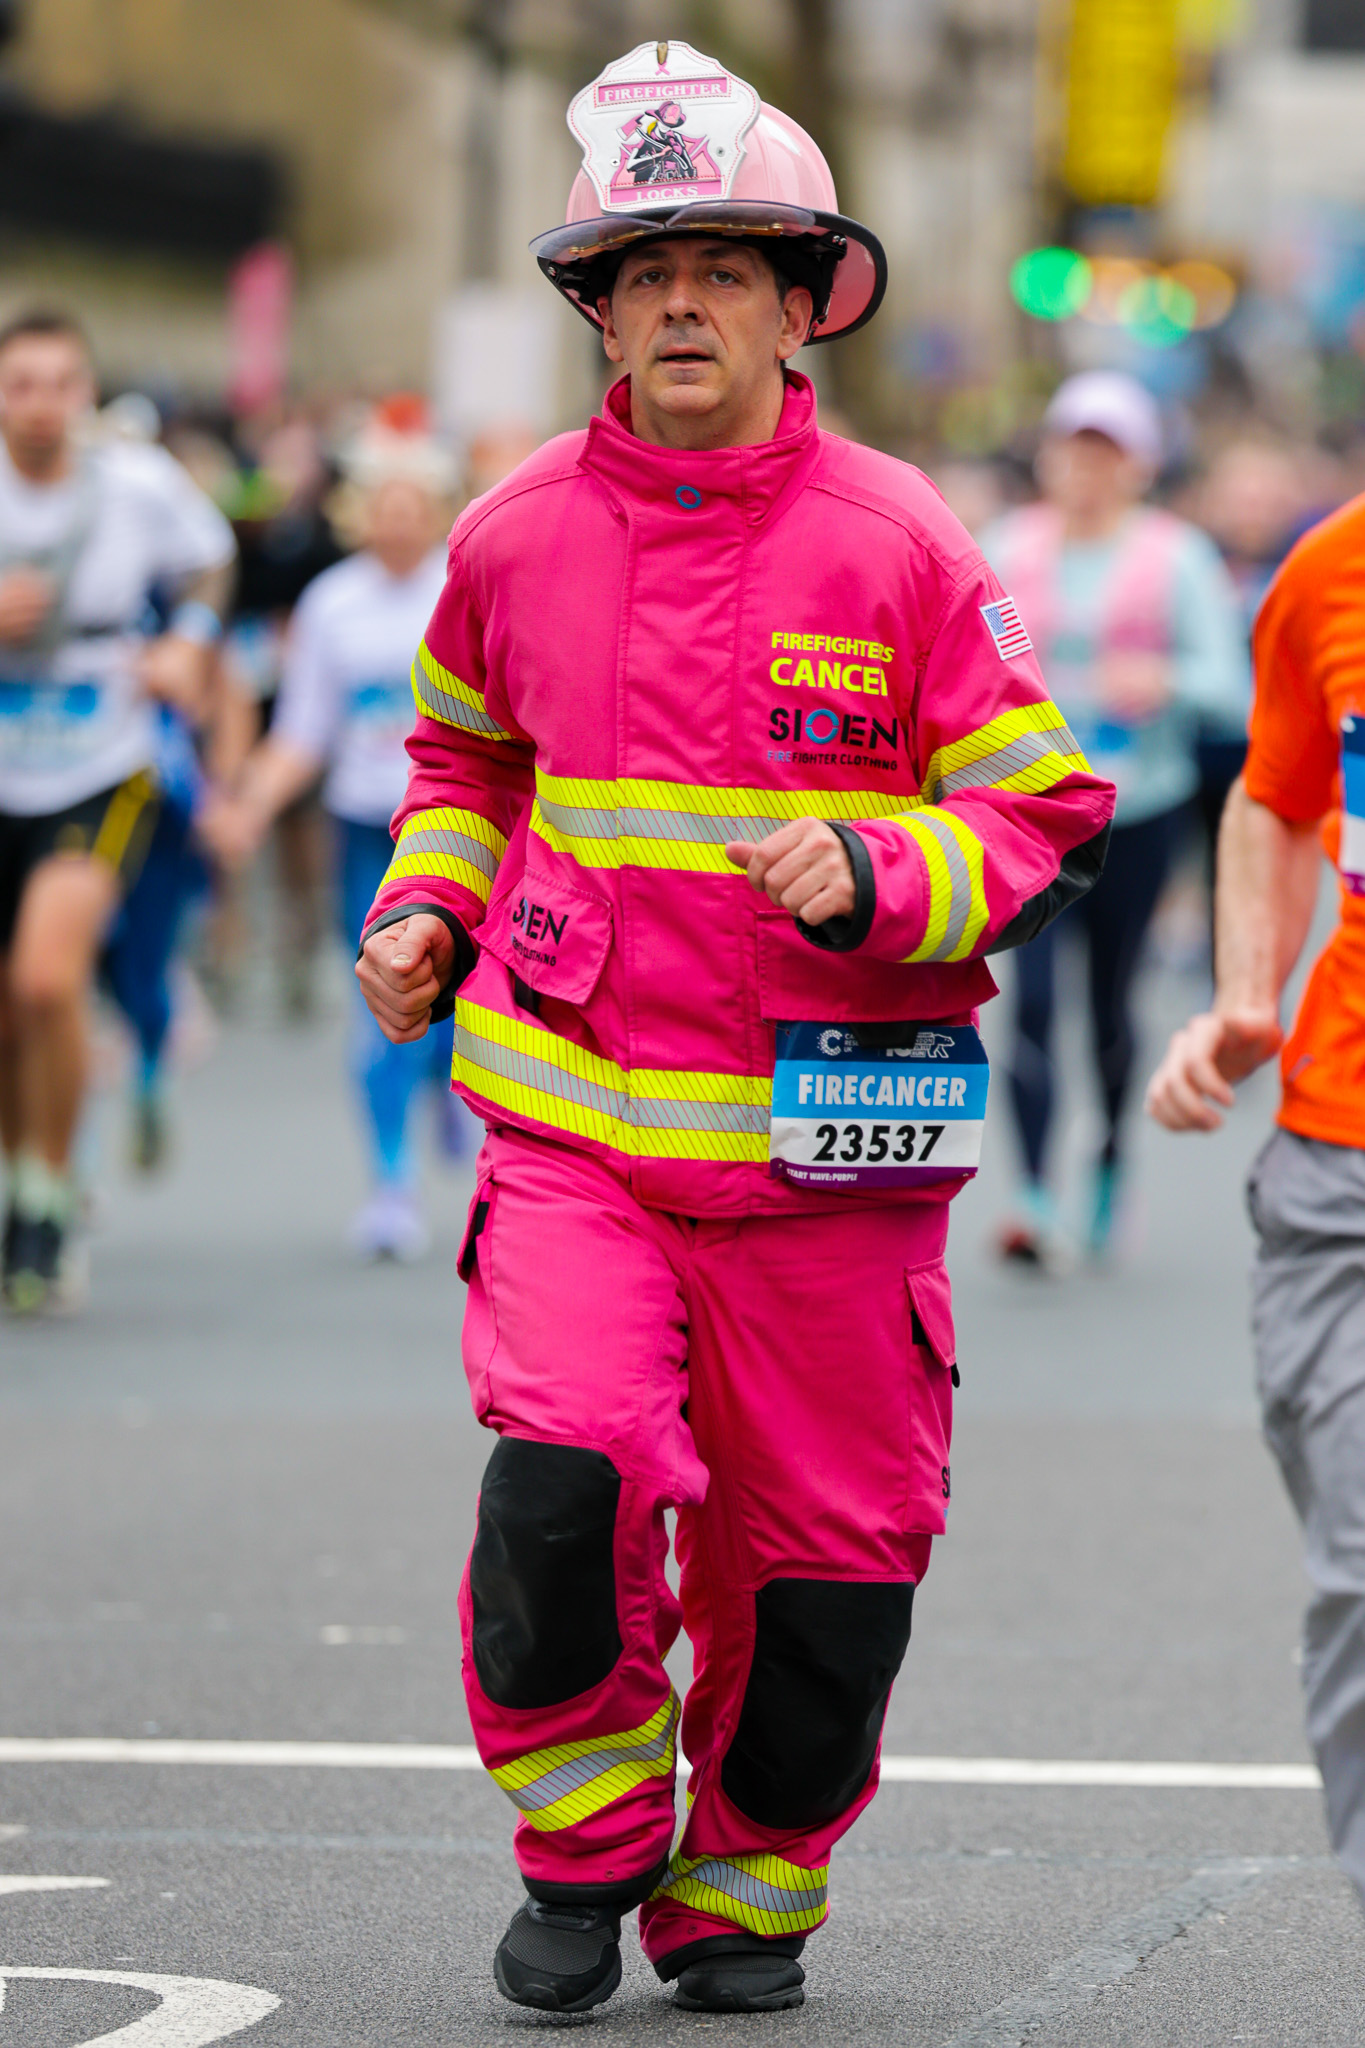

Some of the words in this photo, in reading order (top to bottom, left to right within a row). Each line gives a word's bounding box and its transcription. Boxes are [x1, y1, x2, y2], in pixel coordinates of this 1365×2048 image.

[604, 83, 723, 102] FIREFIGHTER
[637, 186, 698, 201] LOCKS
[771, 631, 895, 663] FIREFIGHTERS
[768, 707, 898, 751] SIOEN
[767, 750, 837, 765] FIREFIGHTER
[839, 753, 898, 771] CLOTHING
[798, 1073, 967, 1107] FIRECANCER
[812, 1124, 946, 1162] 23537
[786, 1167, 808, 1180] START
